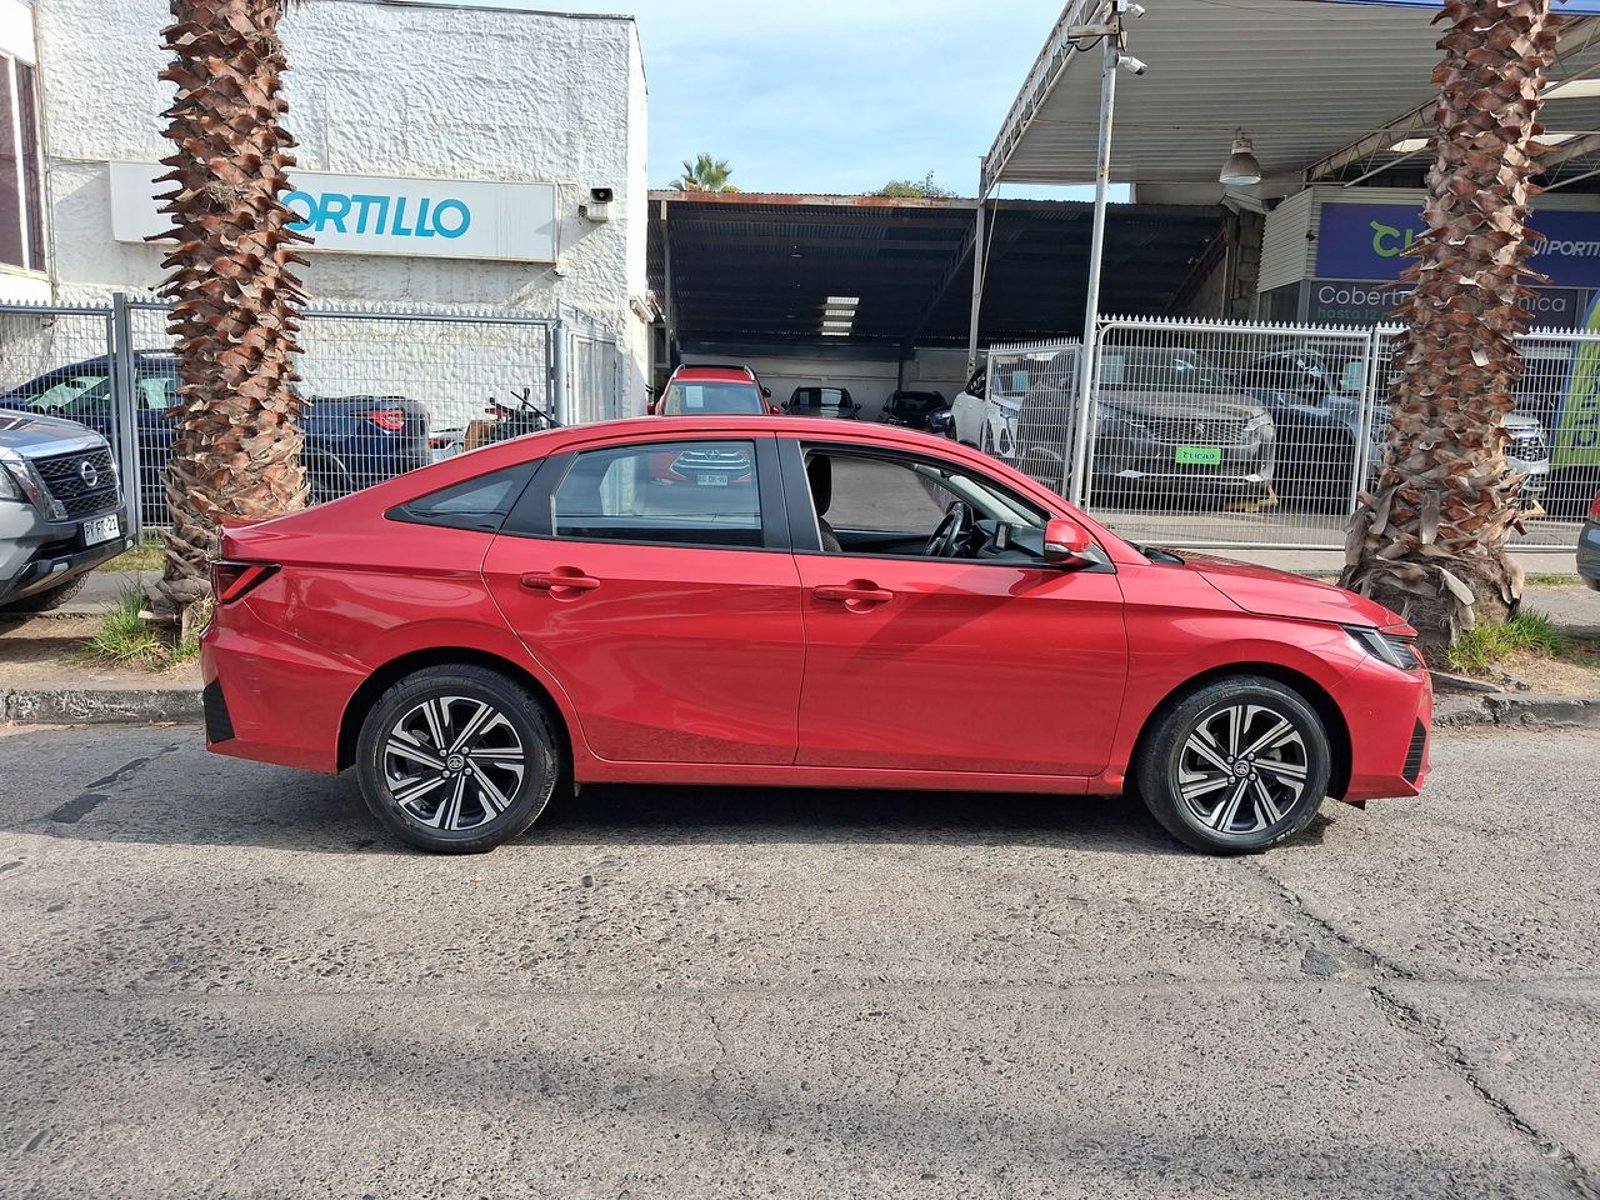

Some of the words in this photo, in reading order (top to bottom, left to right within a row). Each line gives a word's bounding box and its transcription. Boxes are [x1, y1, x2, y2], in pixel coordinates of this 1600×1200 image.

[280, 190, 471, 239] ORTILLO
[1318, 286, 1405, 306] Cobert
[1518, 296, 1567, 313] nica
